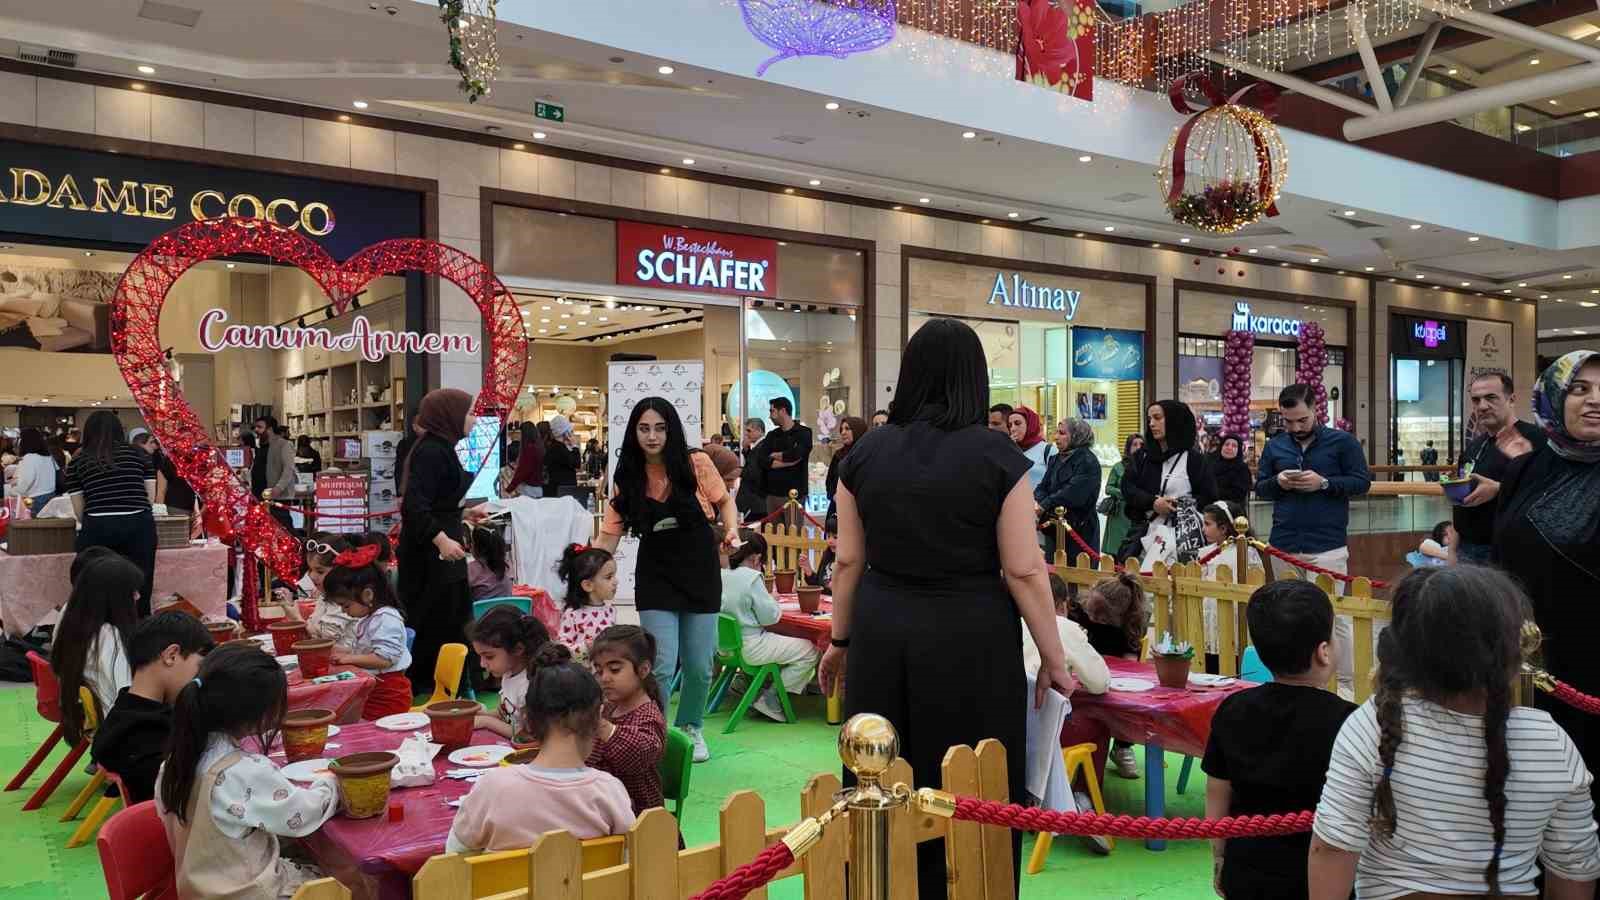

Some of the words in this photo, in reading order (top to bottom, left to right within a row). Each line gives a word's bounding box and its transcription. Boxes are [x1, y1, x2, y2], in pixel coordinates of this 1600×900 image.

[0, 167, 177, 220] DAME
[190, 190, 336, 236] COCO
[988, 271, 1081, 321] Altınay
[198, 308, 338, 352] Canım
[338, 315, 480, 363] Annem
[1249, 314, 1300, 336] karaca
